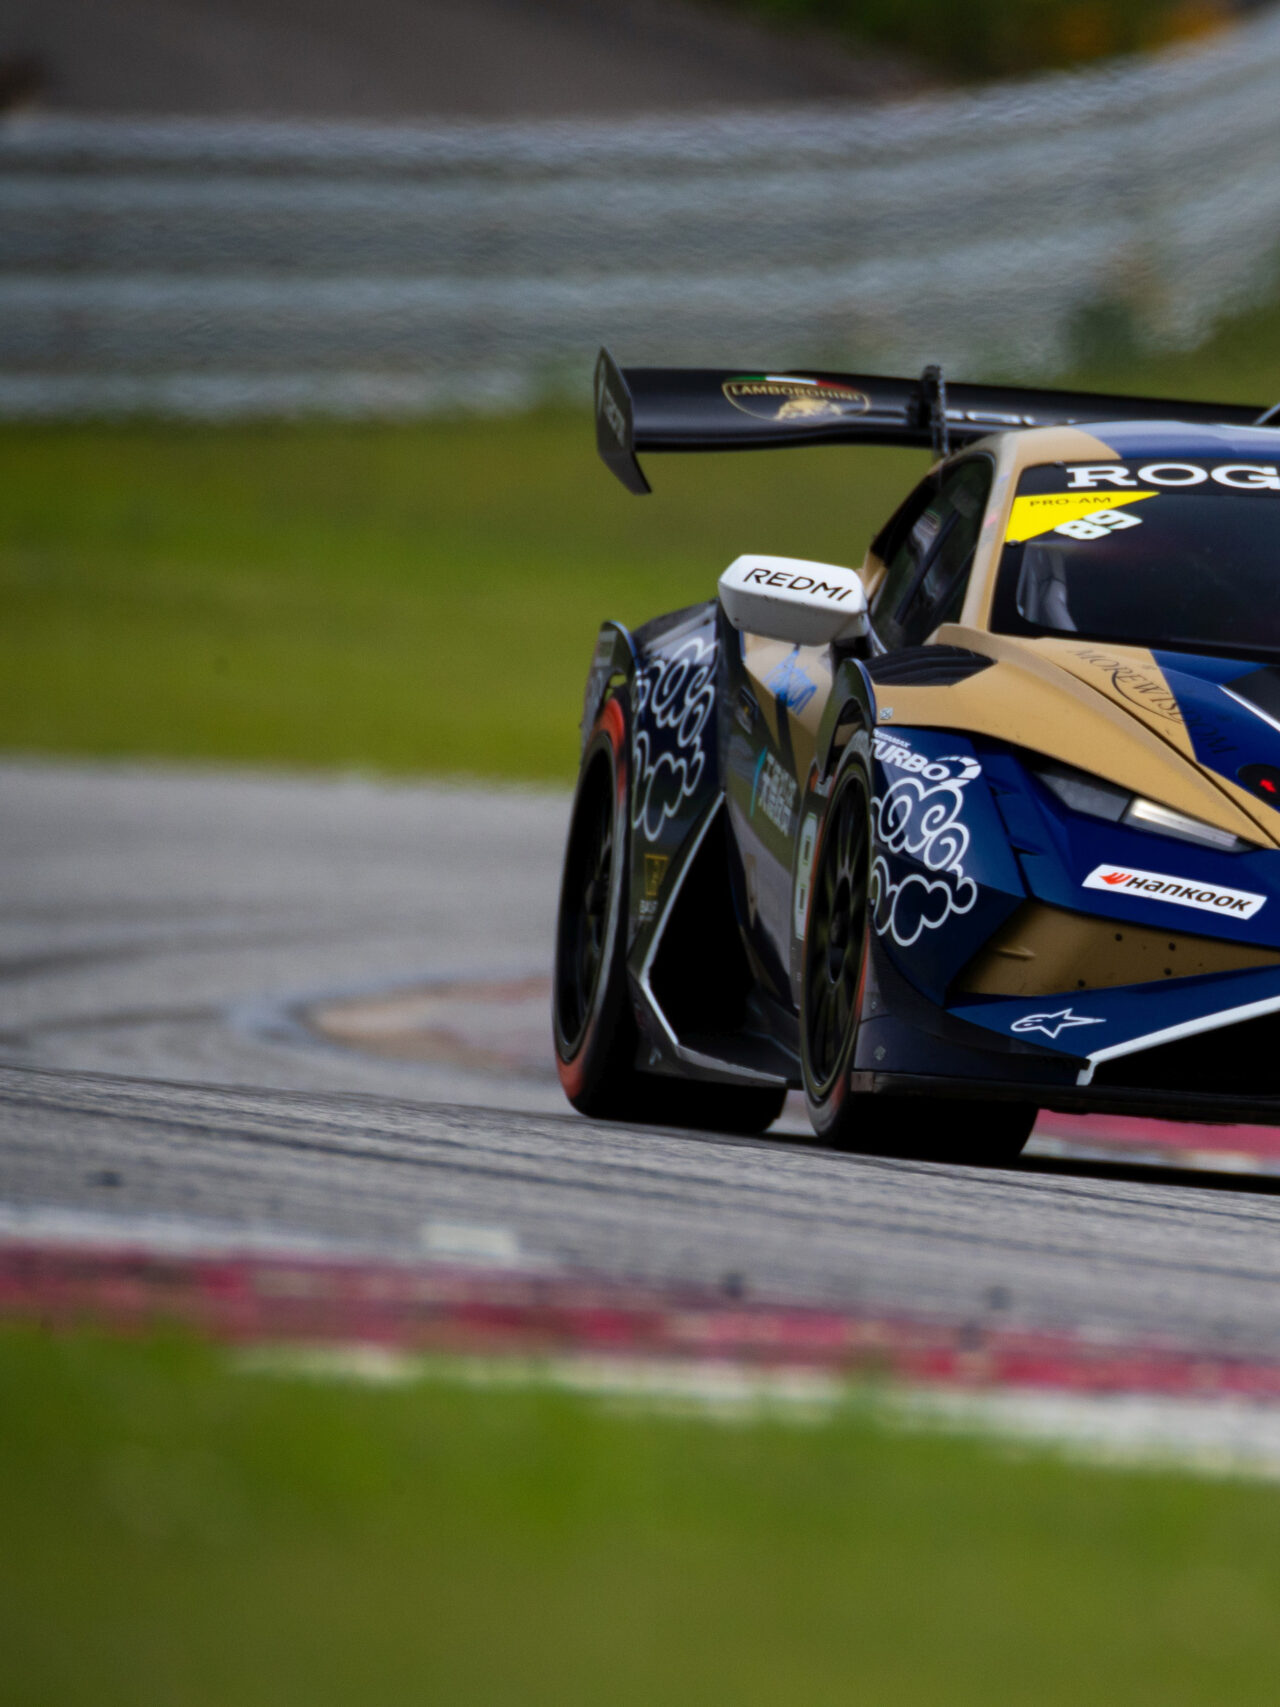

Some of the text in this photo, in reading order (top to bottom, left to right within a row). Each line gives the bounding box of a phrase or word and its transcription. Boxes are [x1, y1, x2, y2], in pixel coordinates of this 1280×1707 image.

[1029, 496, 1112, 507] PRO-AM
[1053, 509, 1144, 541] 89
[743, 567, 853, 602] REDMI
